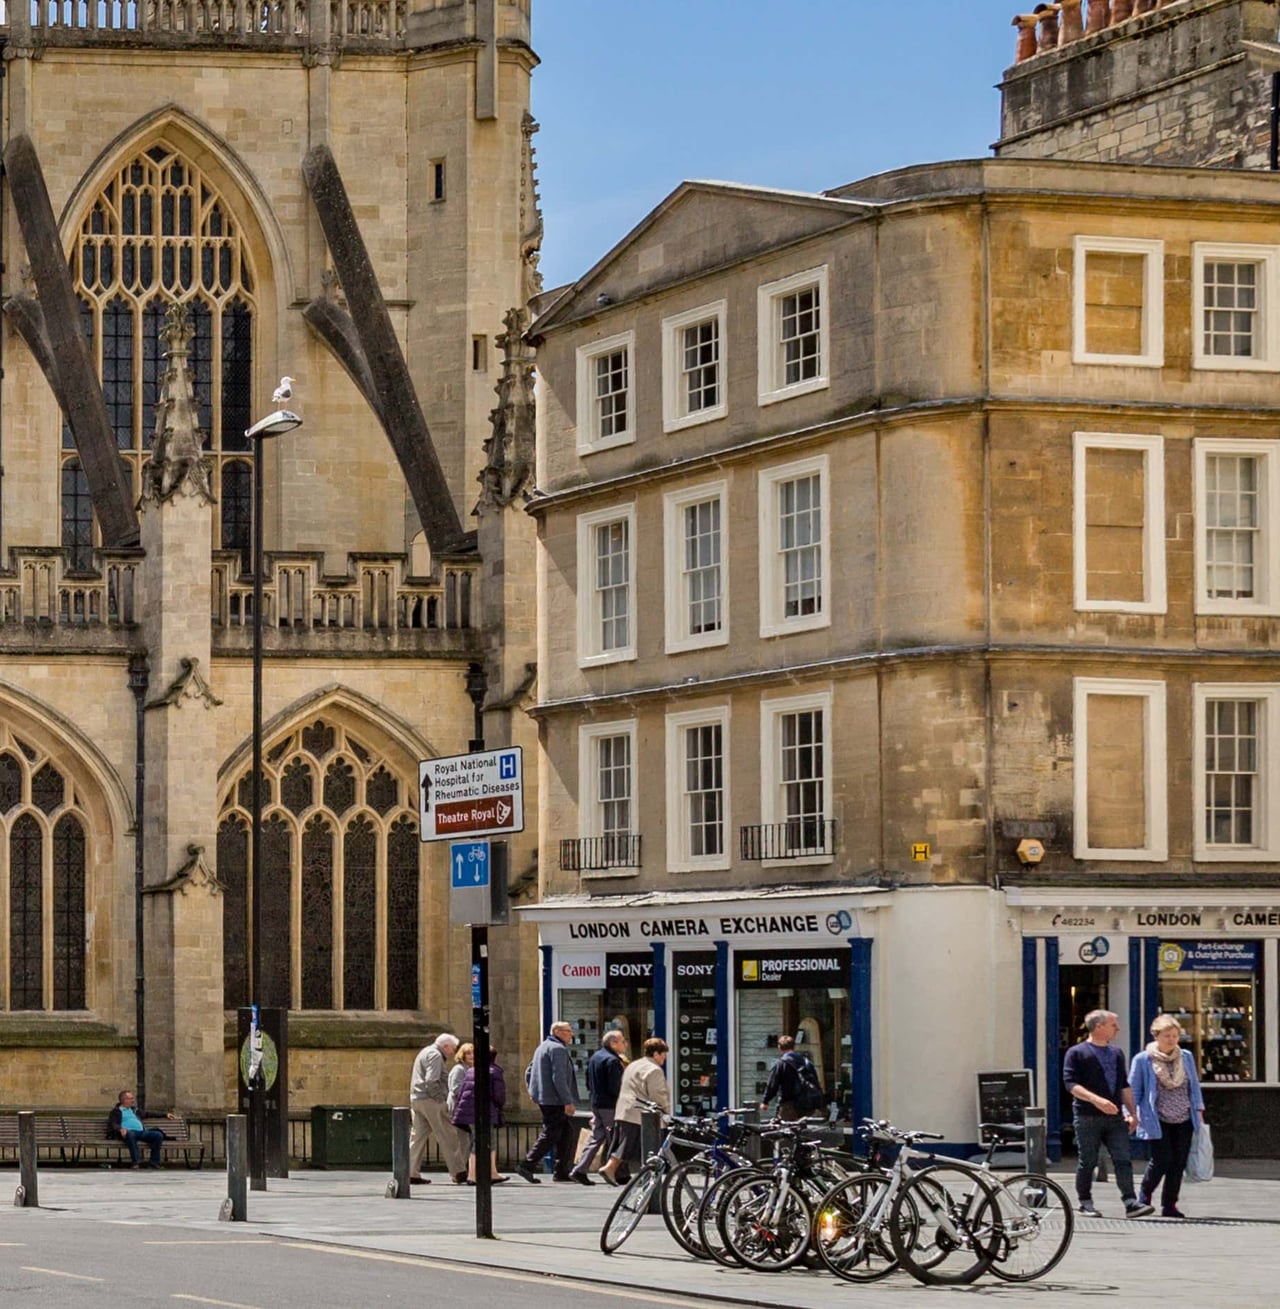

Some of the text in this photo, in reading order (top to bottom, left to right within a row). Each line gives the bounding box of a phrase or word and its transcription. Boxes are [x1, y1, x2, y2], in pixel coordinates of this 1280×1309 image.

[435, 756, 497, 775] Royal National
[502, 757, 514, 777] H
[435, 773, 484, 788] Hospital for
[435, 782, 520, 800] Rheumatic Diseases
[438, 808, 495, 824] Theatre Royal
[1138, 912, 1280, 926] LONDON CAME
[570, 922, 630, 939] LONDON
[641, 919, 709, 936] CAMERA
[721, 915, 819, 934] EXCHANGE
[1197, 943, 1244, 951] Part-Exchange
[1195, 951, 1222, 960] Outright
[1224, 951, 1255, 959] Purchase
[562, 964, 601, 977] Canon
[609, 964, 653, 976] SONY
[677, 965, 715, 976] SONY
[762, 959, 840, 971] PROFESSIONAL
[762, 973, 782, 981] Dealer
